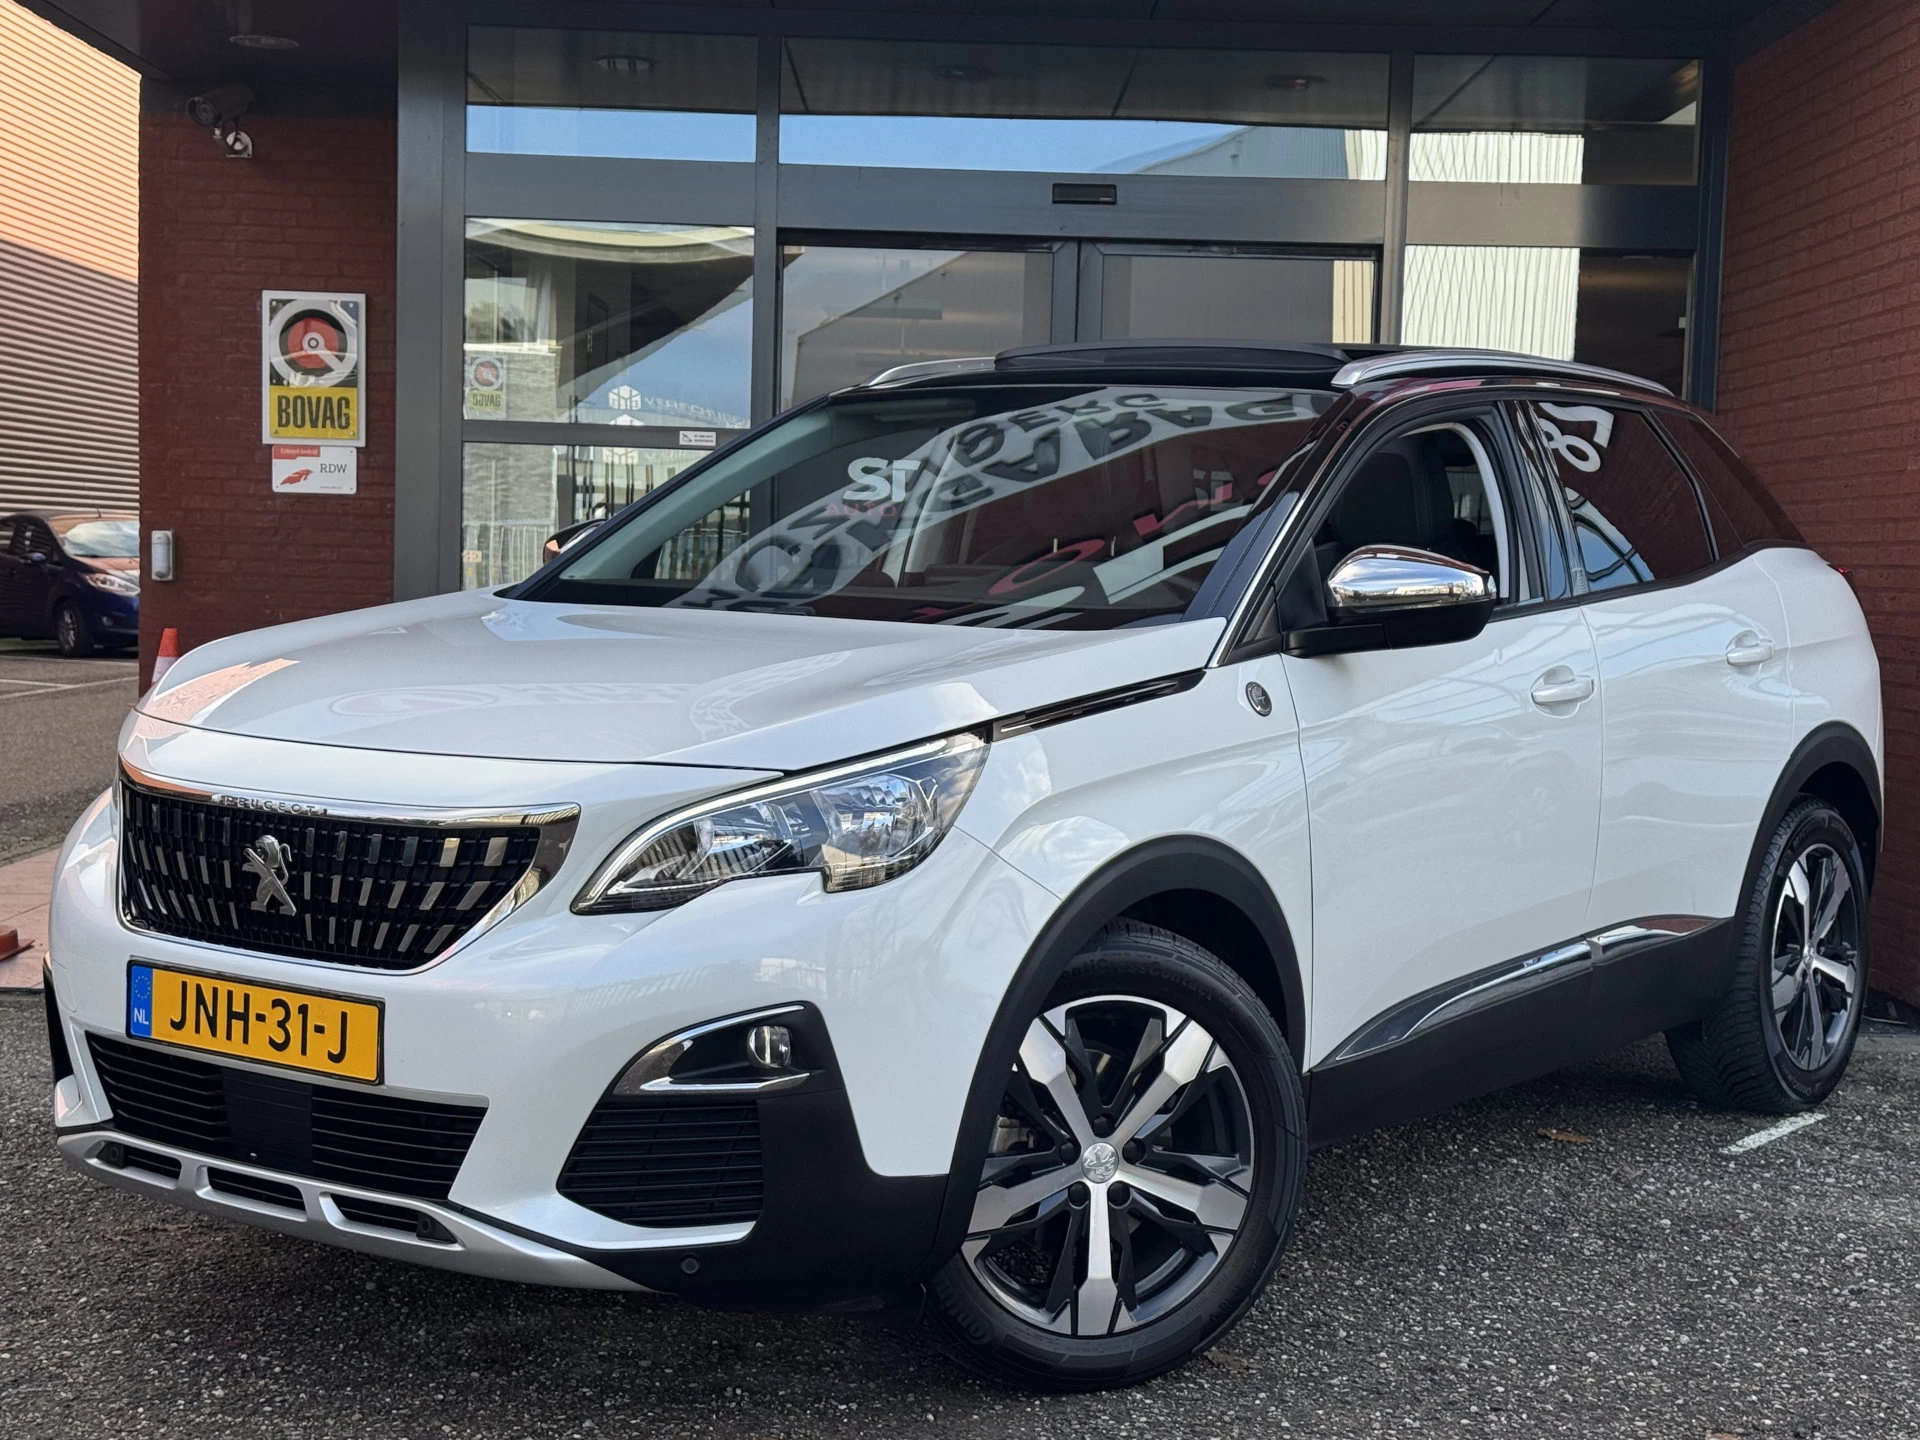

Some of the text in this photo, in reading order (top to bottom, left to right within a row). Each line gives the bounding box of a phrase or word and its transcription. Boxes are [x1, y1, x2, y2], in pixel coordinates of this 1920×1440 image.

[277, 394, 351, 430] BOVAG
[319, 463, 347, 474] RDW
[823, 502, 898, 518] AUTO
[223, 795, 316, 816] PEUGEOT
[133, 1007, 150, 1026] NL
[170, 980, 348, 1064] JNH-31-J
